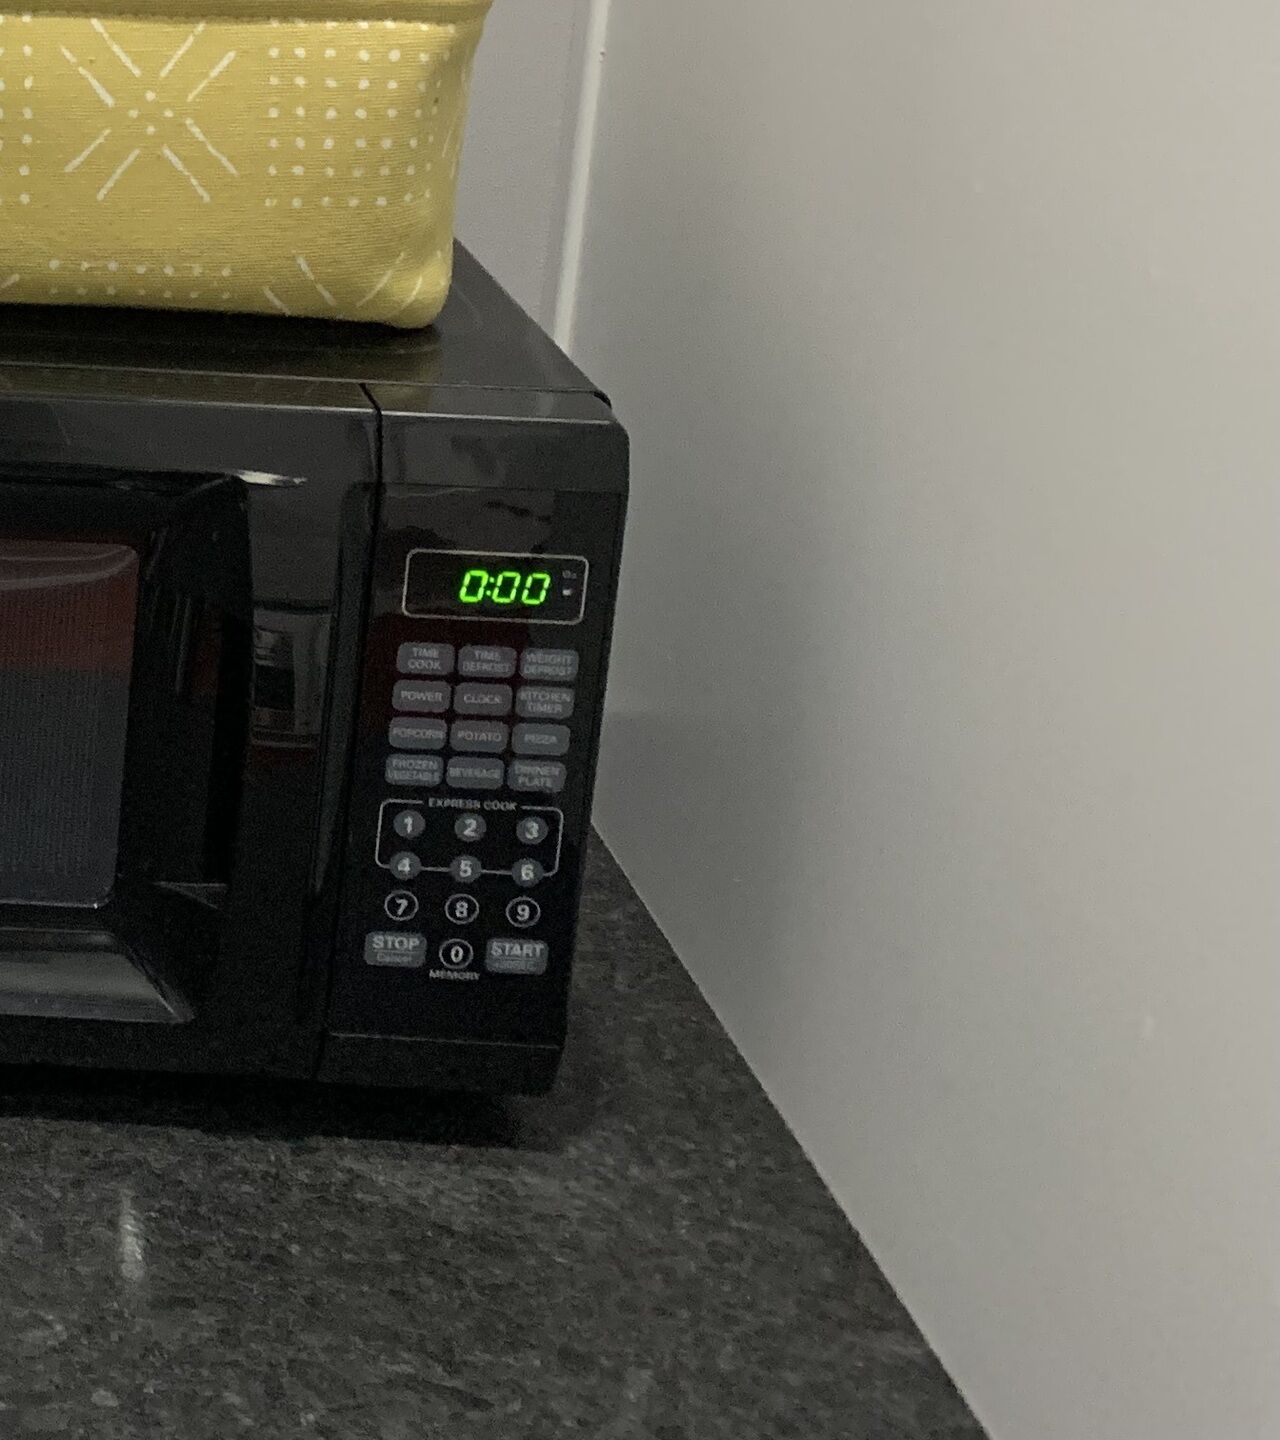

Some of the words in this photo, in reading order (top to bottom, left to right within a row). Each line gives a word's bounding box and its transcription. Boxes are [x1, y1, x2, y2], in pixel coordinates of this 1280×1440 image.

[459, 569, 551, 605] 0:00
[400, 690, 443, 702] POWER
[463, 694, 502, 705] CLOCK
[520, 691, 571, 702] KITCHEN
[458, 731, 503, 742] POTATO
[524, 734, 558, 745] PIZZA
[393, 758, 439, 770] FROZEN
[449, 767, 501, 779] BEVERAGE
[428, 797, 481, 810] EXPRESS
[483, 799, 518, 811] COOK
[404, 815, 414, 834] 1
[463, 818, 477, 837] 2
[525, 820, 539, 839] 3
[397, 857, 411, 874] 4
[459, 860, 472, 877] 5
[521, 863, 534, 881] 6
[395, 898, 409, 916] 7
[455, 900, 468, 918] 8
[516, 904, 530, 921] 9
[372, 935, 420, 951] STOP
[490, 941, 545, 957] START
[450, 945, 464, 963] 0
[429, 968, 481, 981] MEMORY
